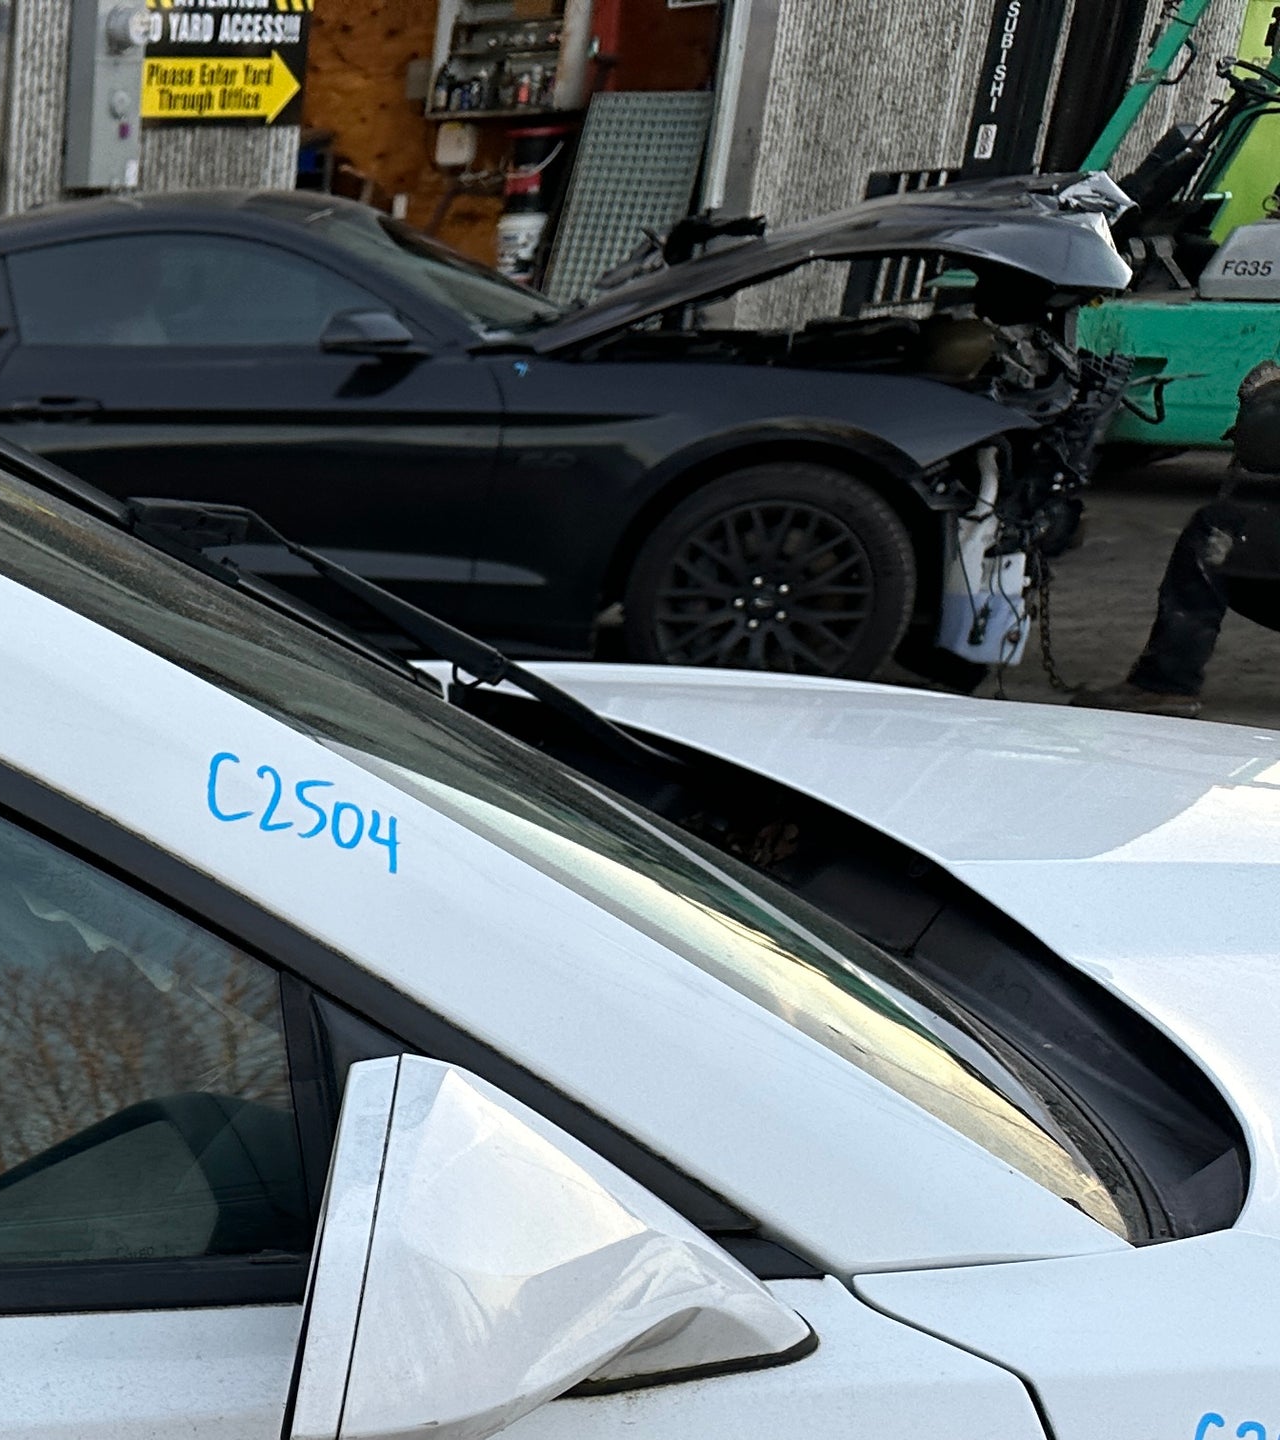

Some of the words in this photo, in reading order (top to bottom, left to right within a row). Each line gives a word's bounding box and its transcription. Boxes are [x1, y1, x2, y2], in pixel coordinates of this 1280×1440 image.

[168, 12, 215, 43] YARD
[146, 62, 194, 86] Please
[199, 62, 238, 86] Enter
[243, 62, 274, 87] Yard
[159, 88, 213, 114] Through
[218, 88, 261, 110] Office
[1222, 260, 1272, 276] FG35
[207, 752, 401, 874] C2504
